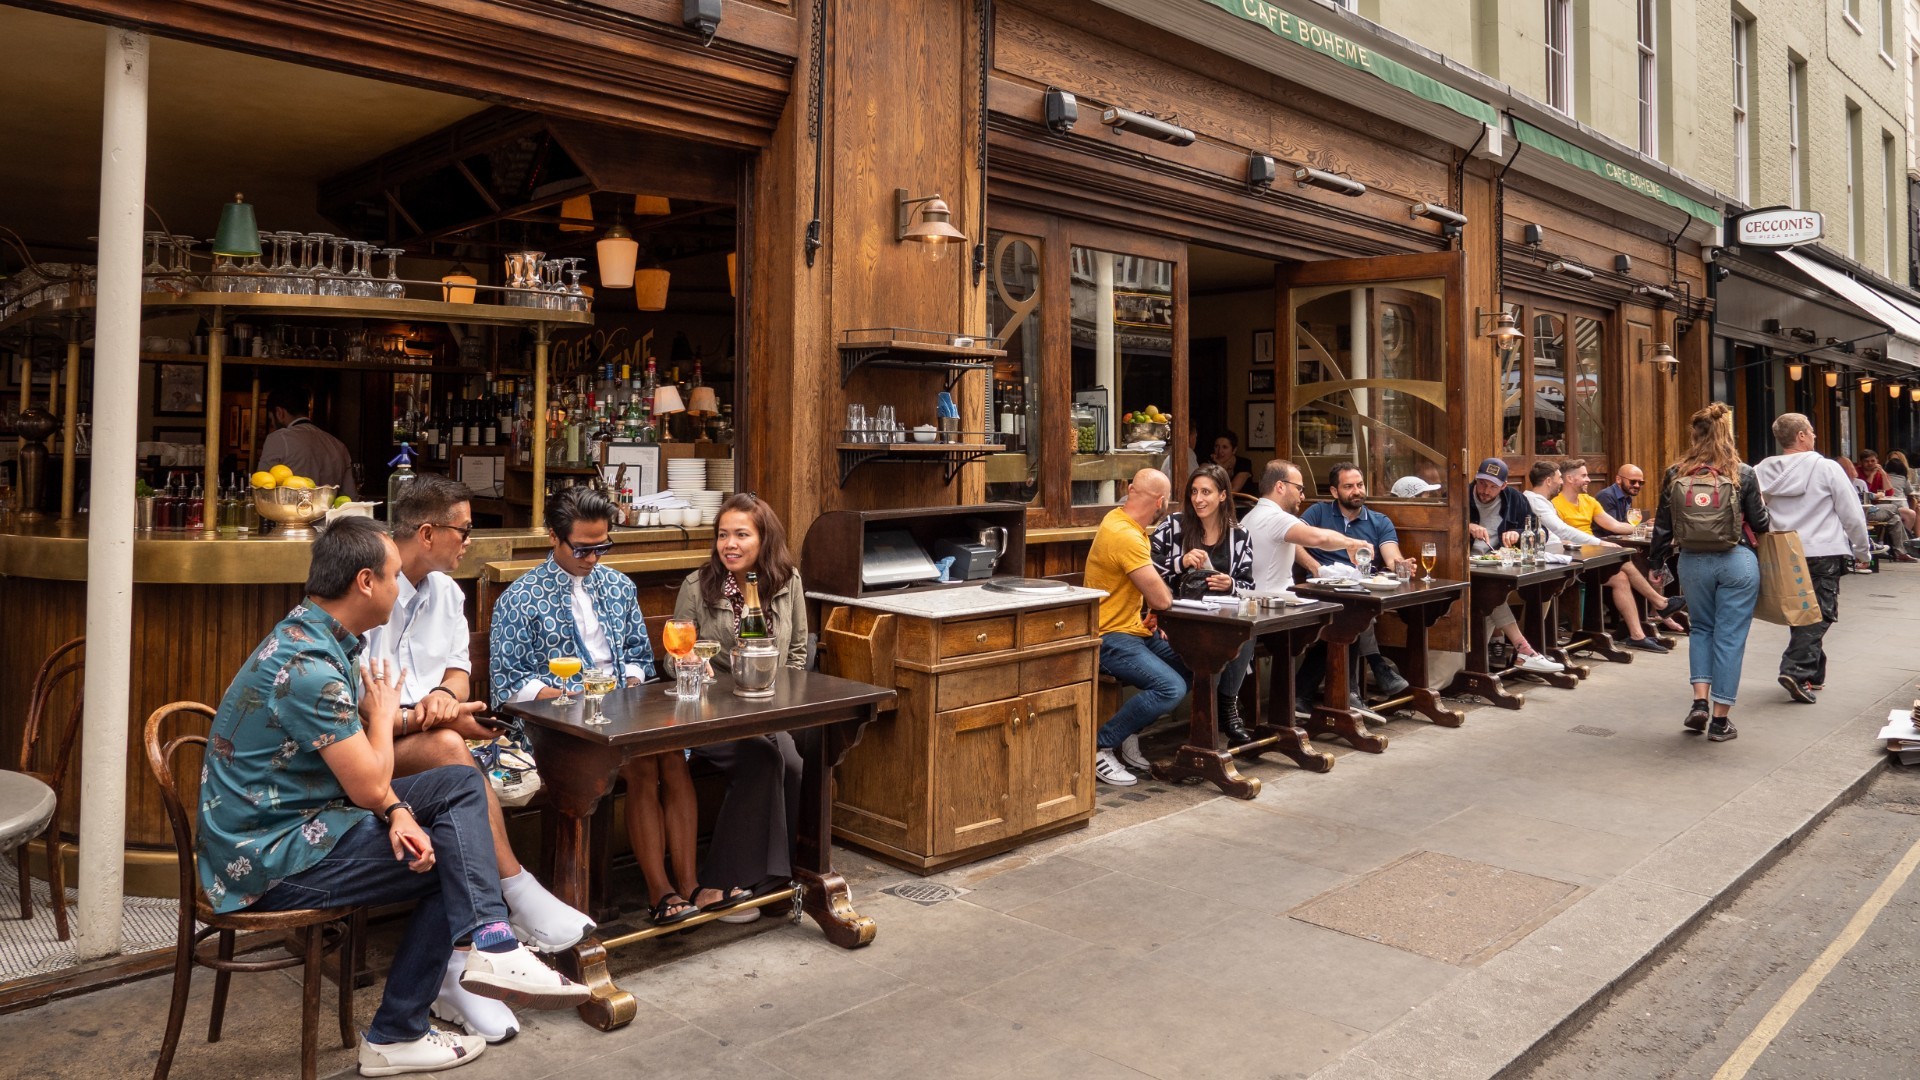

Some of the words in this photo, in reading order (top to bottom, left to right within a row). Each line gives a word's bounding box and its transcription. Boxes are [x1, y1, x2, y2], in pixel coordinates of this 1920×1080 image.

[1242, 0, 1292, 34] CAFE
[1297, 19, 1371, 67] BOHEME
[1605, 163, 1629, 183] CAFE
[1629, 173, 1663, 198] BOHEME
[1745, 217, 1814, 233] CECCONI'S
